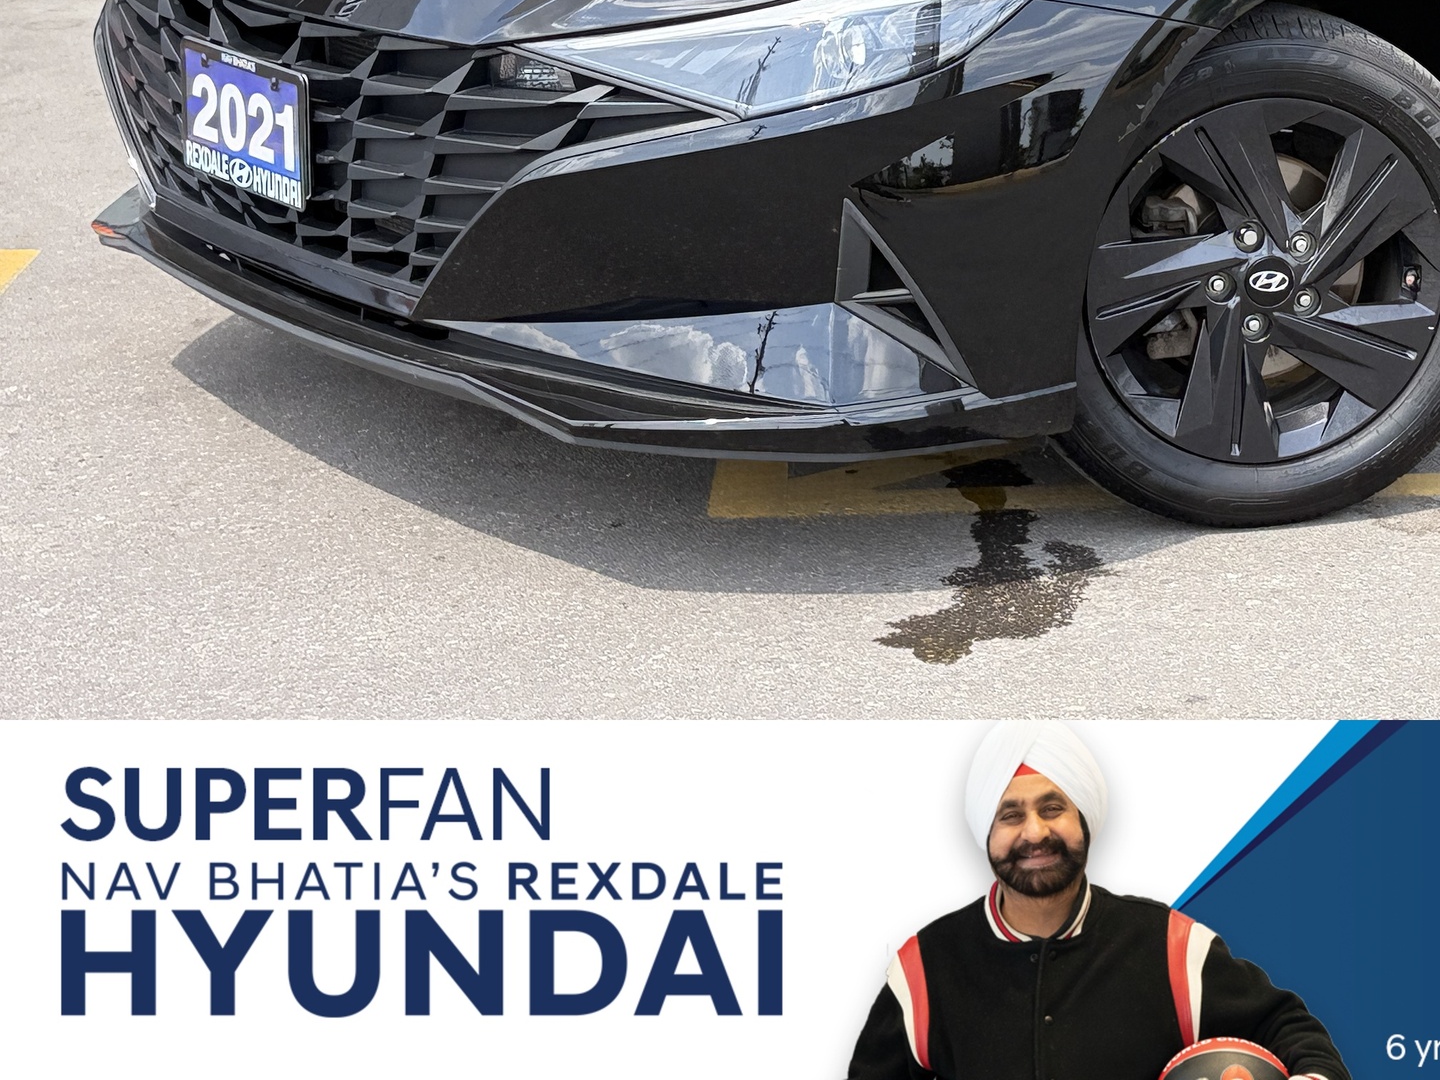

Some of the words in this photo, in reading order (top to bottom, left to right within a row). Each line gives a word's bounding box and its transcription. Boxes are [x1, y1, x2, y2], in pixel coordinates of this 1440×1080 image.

[192, 73, 295, 172] 2021
[186, 139, 230, 181] REXDALE
[252, 165, 302, 209] HYUNDAI
